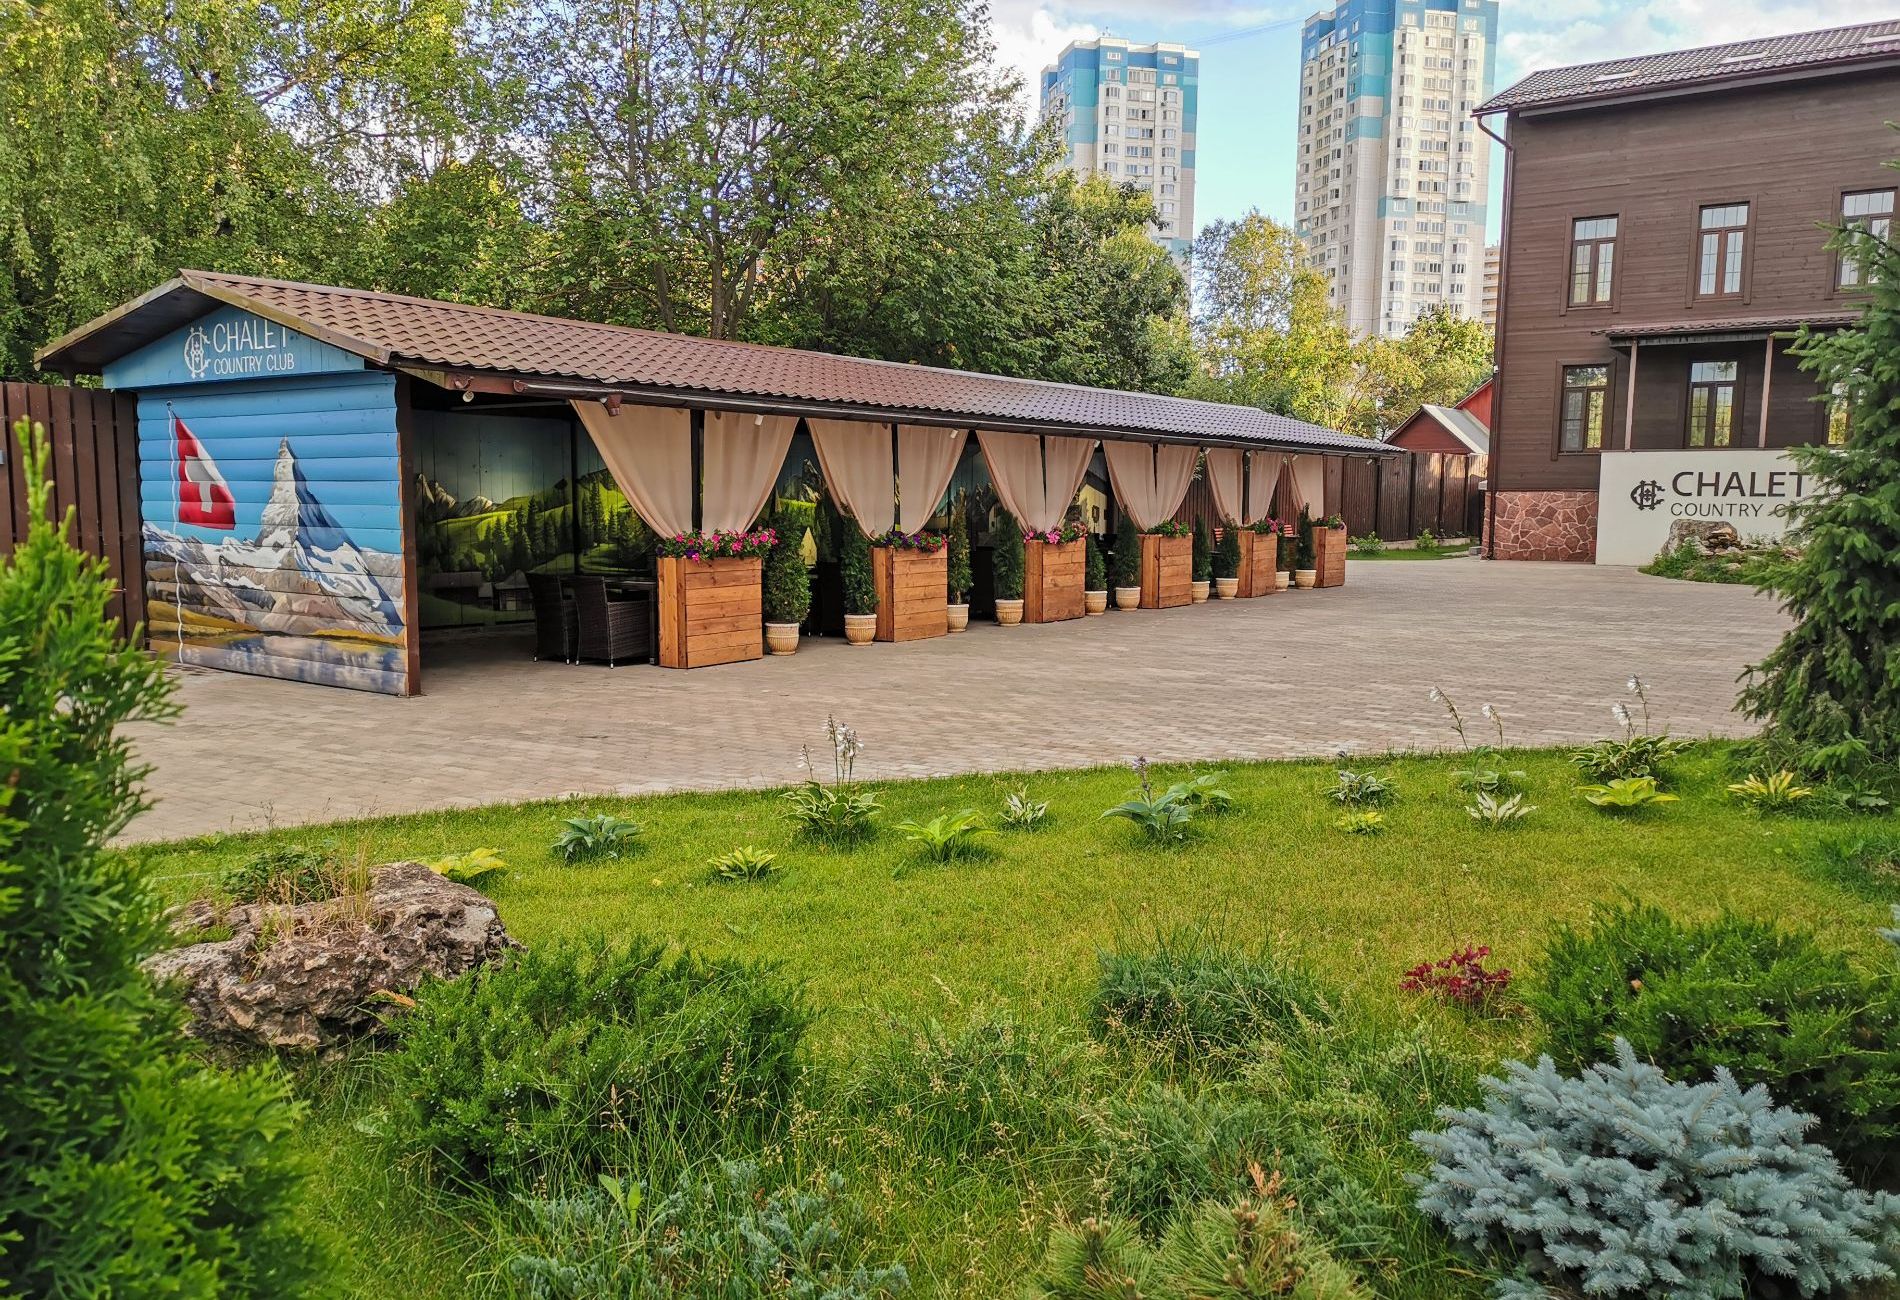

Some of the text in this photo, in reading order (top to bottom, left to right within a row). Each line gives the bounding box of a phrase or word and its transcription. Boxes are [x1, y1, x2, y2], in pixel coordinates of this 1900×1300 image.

[214, 353, 294, 375] COUNTRY CLUB
[1672, 471, 1811, 497] CHALET
[1671, 503, 1764, 517] COUNTRY
